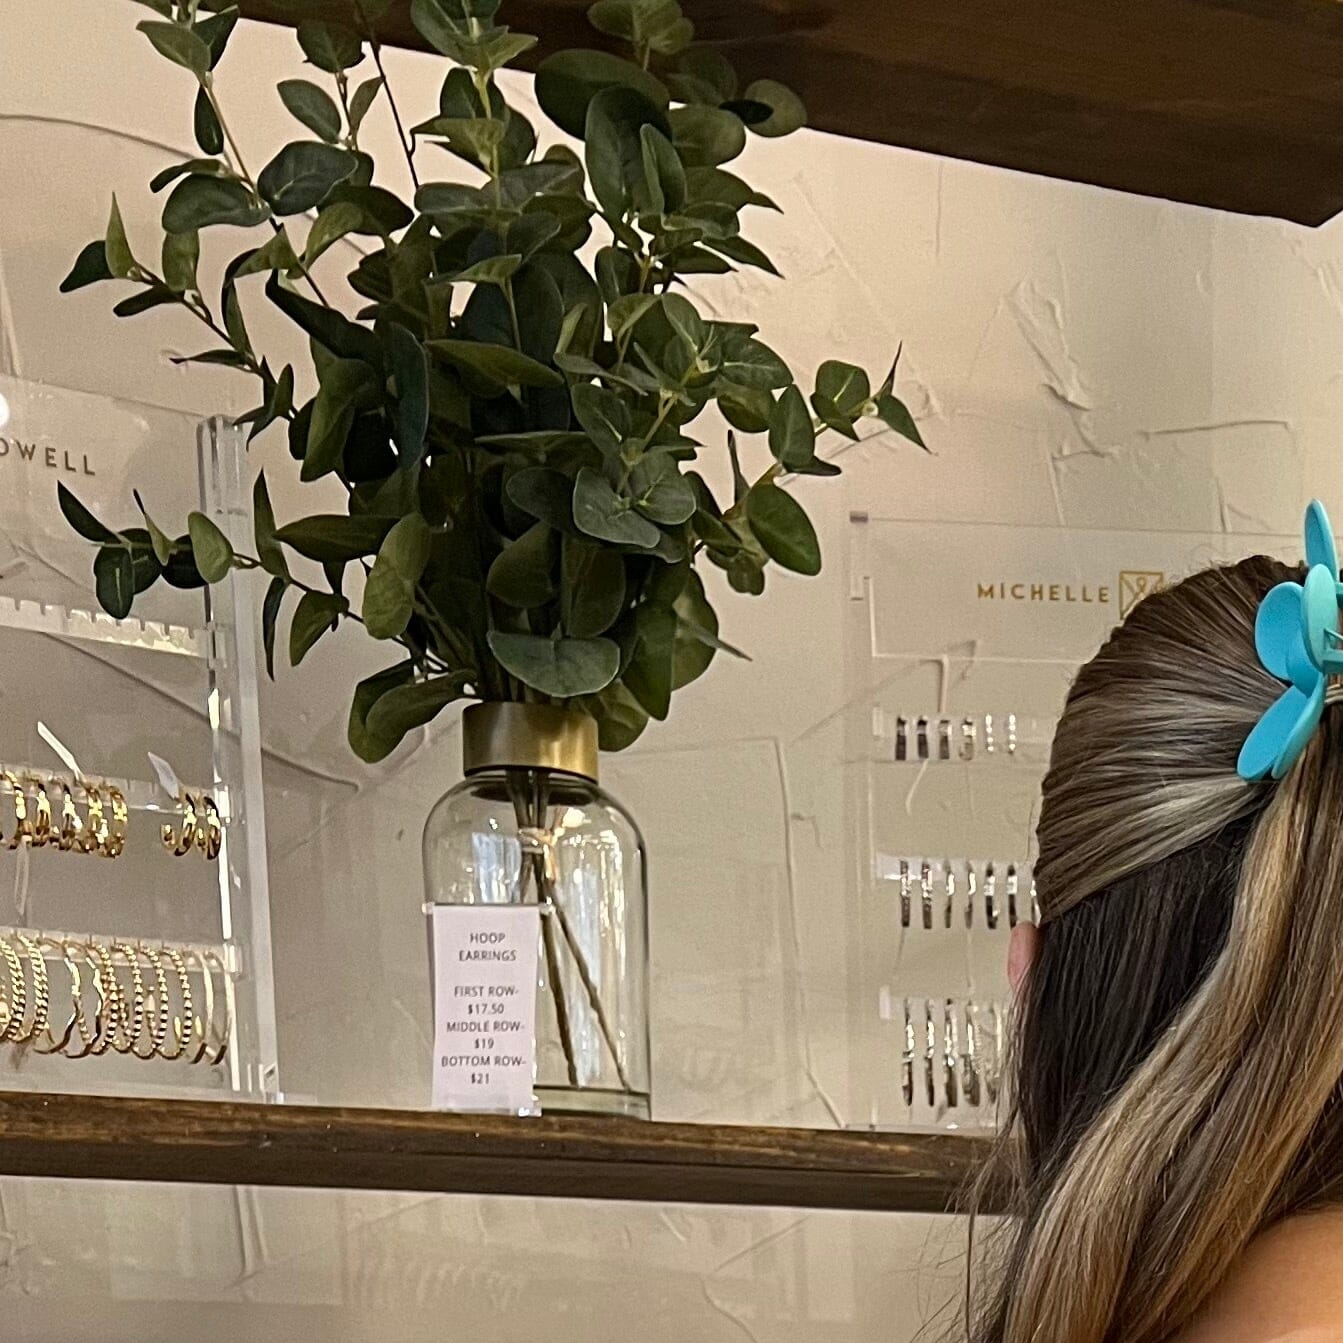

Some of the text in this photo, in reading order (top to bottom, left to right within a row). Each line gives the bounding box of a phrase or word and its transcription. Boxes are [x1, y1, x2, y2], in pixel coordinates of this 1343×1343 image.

[977, 582, 1109, 603] MICHELLE
[469, 932, 506, 944] HOOP
[458, 950, 517, 962] EARRINGS
[454, 986, 484, 997] FIRST
[468, 1003, 505, 1015] $17.50
[446, 1021, 490, 1033] MIDDLE
[474, 1038, 495, 1050] $19
[441, 1055, 491, 1067] BOTTOM
[471, 1073, 490, 1085] $21
